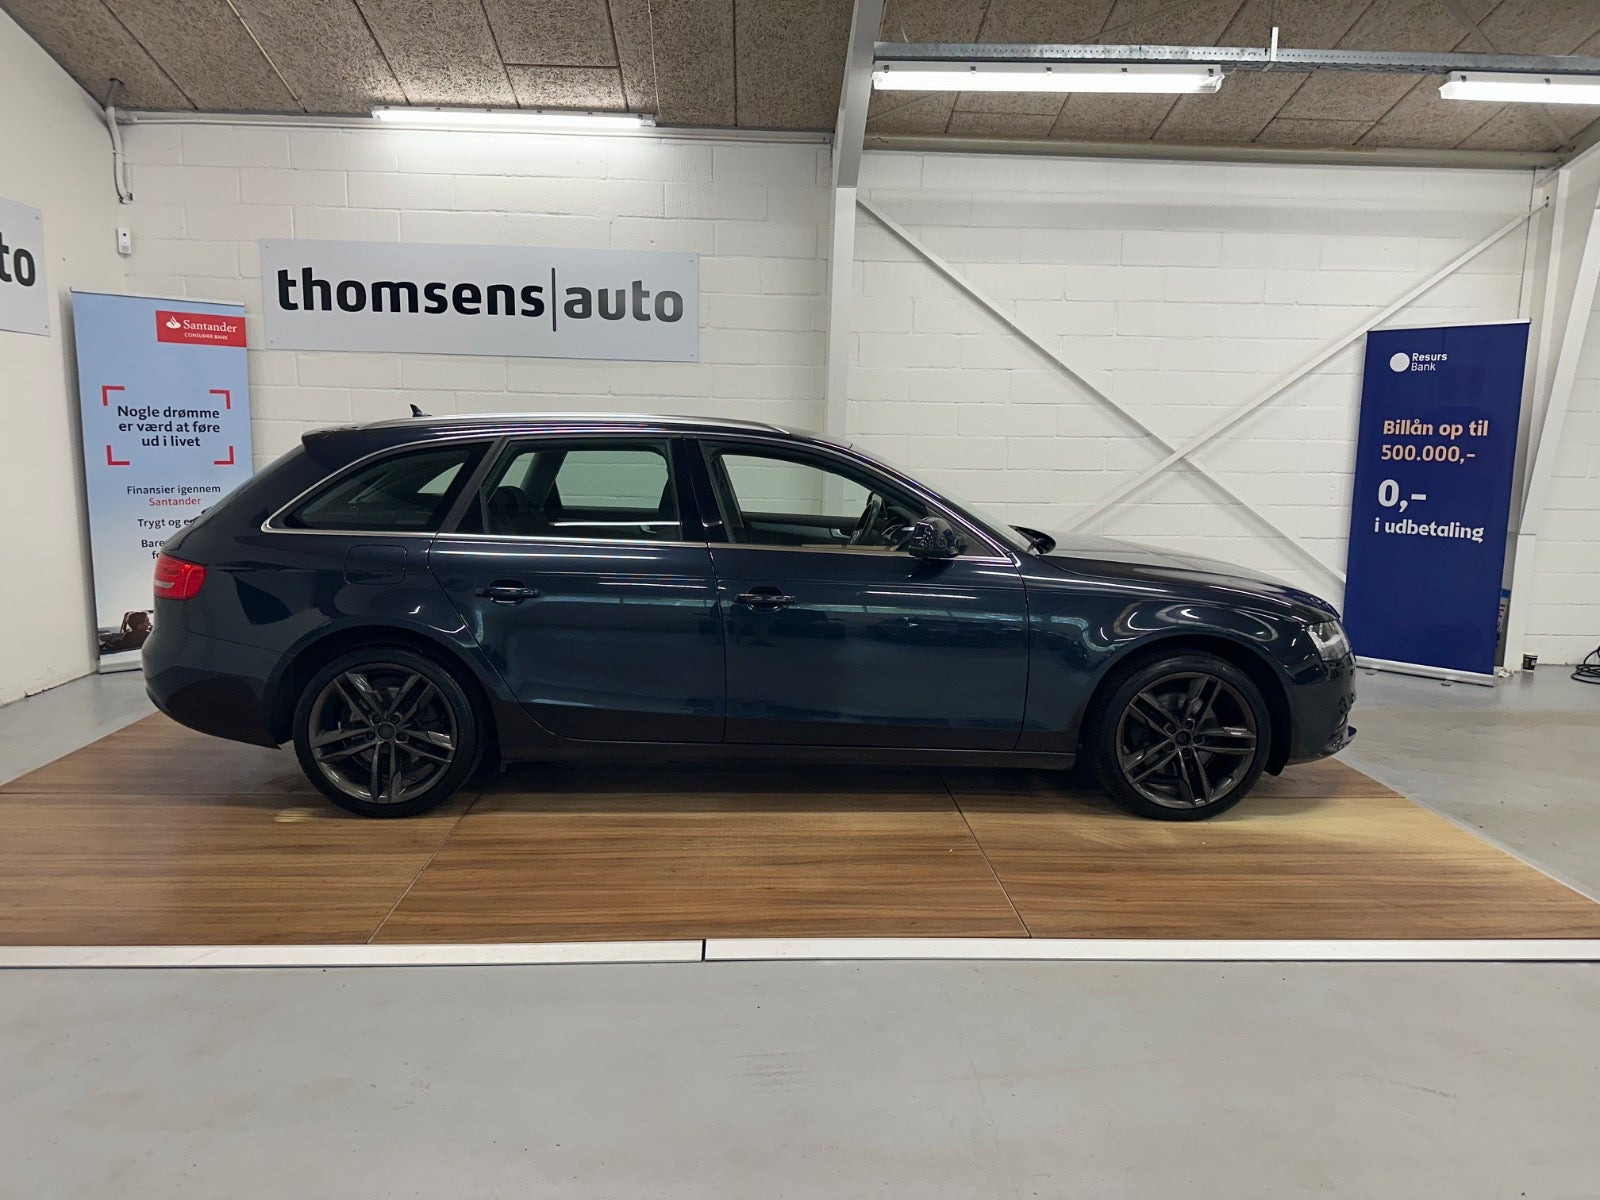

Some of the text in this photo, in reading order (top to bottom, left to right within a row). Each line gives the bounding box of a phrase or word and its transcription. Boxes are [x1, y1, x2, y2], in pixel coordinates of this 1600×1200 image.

[278, 267, 684, 323] thomsens auto
[183, 320, 238, 333] Santander
[1412, 353, 1448, 362] Resurs
[1411, 363, 1436, 372] Bank
[117, 406, 220, 420] Nogle drømme
[118, 421, 221, 433] er værd at føre
[1383, 419, 1489, 440] Billån op til
[142, 435, 201, 447] ud i livet
[127, 485, 221, 496] Finansier igennem
[149, 497, 201, 506] Santander
[137, 518, 165, 529] Trygt
[168, 519, 181, 528] og
[1374, 517, 1485, 543] i udbetaling
[141, 539, 165, 548] Bare
